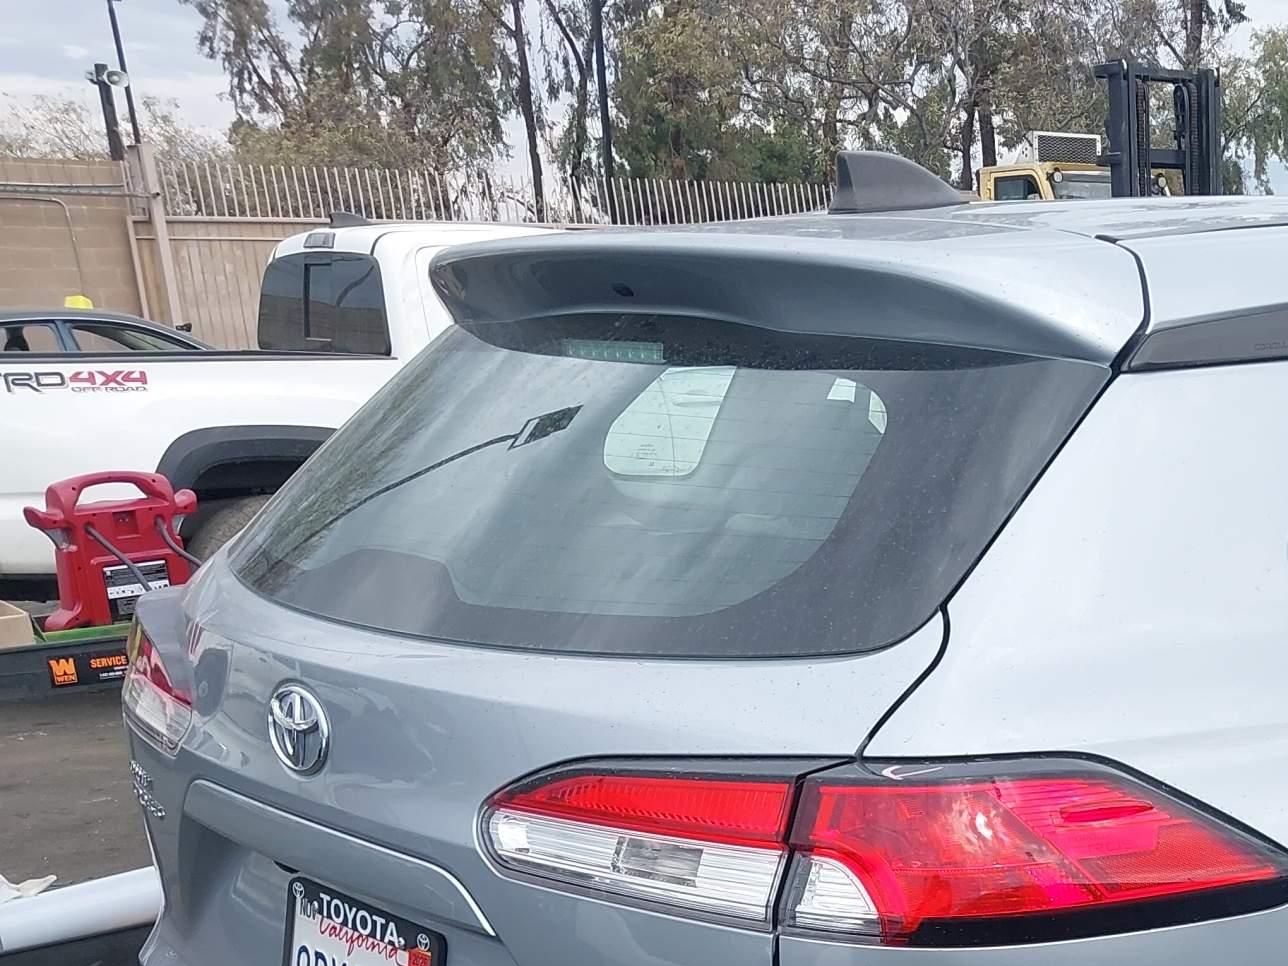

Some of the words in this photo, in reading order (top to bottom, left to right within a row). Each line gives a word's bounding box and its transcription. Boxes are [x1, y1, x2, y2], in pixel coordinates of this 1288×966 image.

[0, 371, 69, 394] RD
[90, 655, 128, 669] SERVICE
[55, 675, 76, 683] WEN
[319, 892, 398, 947] TOYOTA
